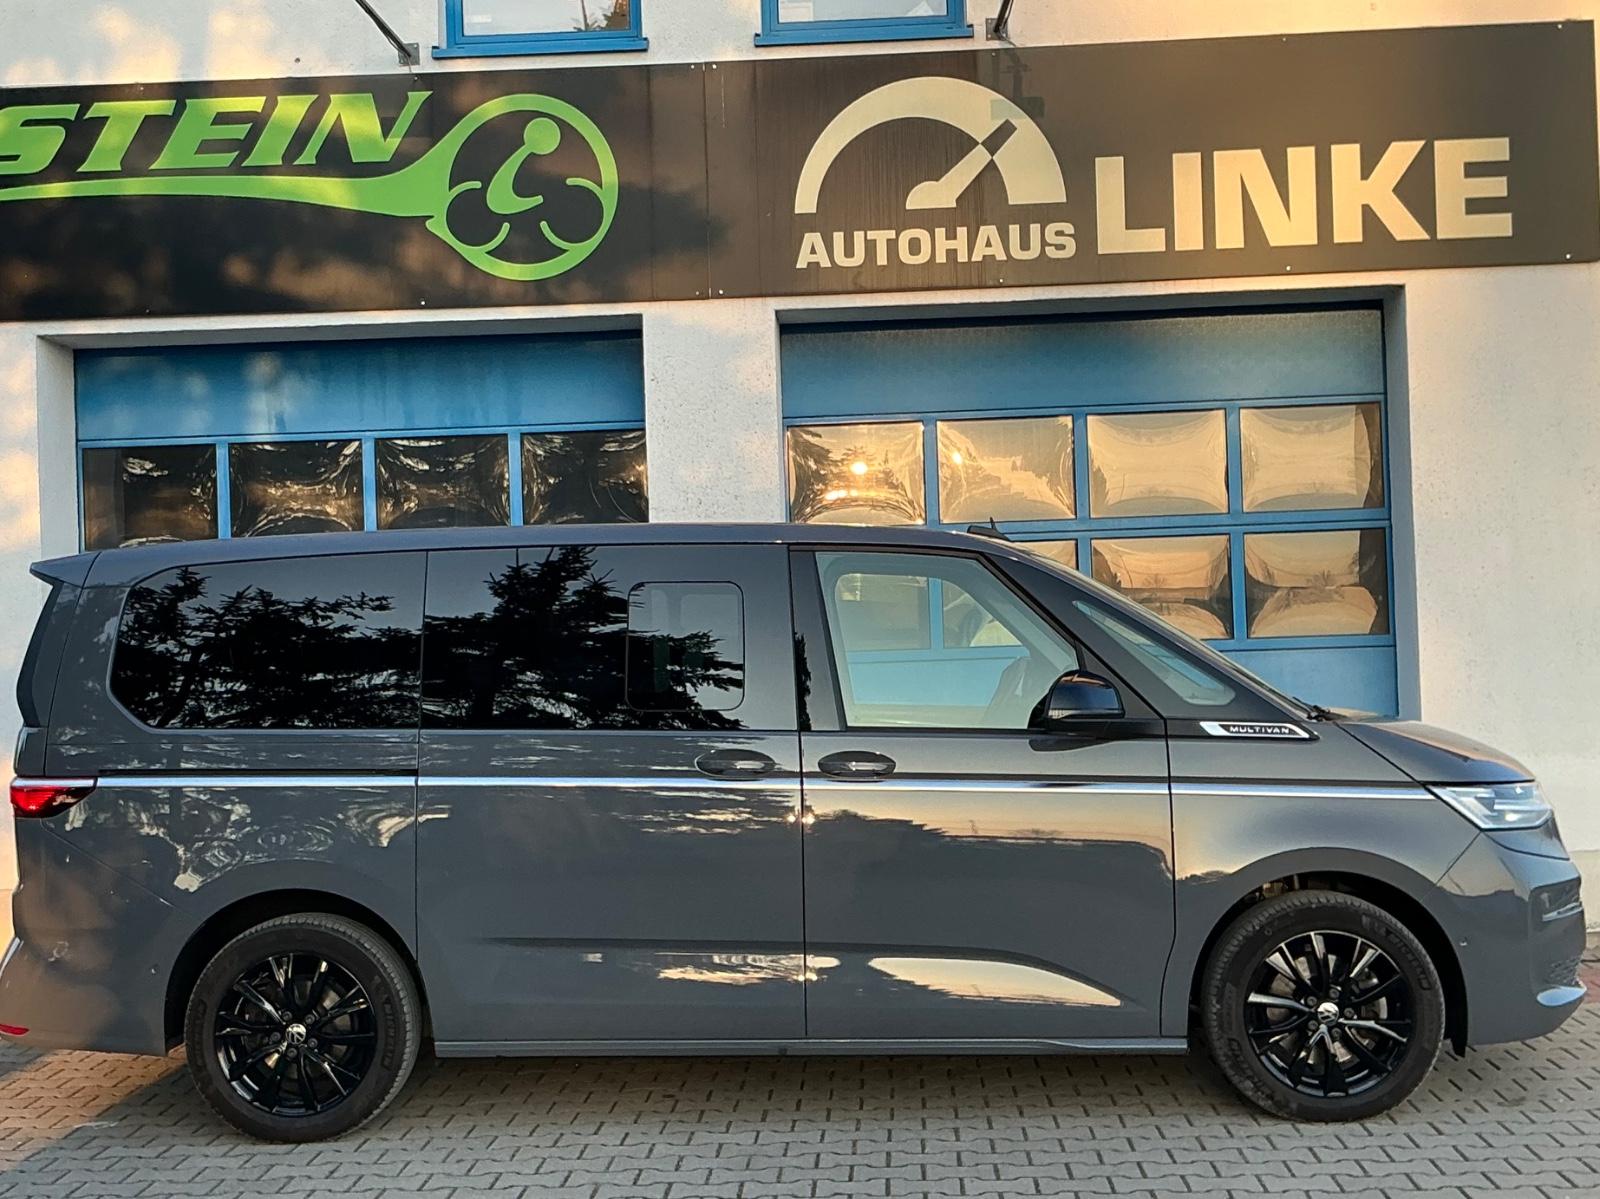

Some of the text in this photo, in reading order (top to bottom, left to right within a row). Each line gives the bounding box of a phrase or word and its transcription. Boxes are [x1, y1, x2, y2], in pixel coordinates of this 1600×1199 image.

[0, 91, 433, 174] STEIN
[795, 137, 1513, 269] AUTOHAUS LINKE
[1229, 725, 1290, 734] MULTIVAN
